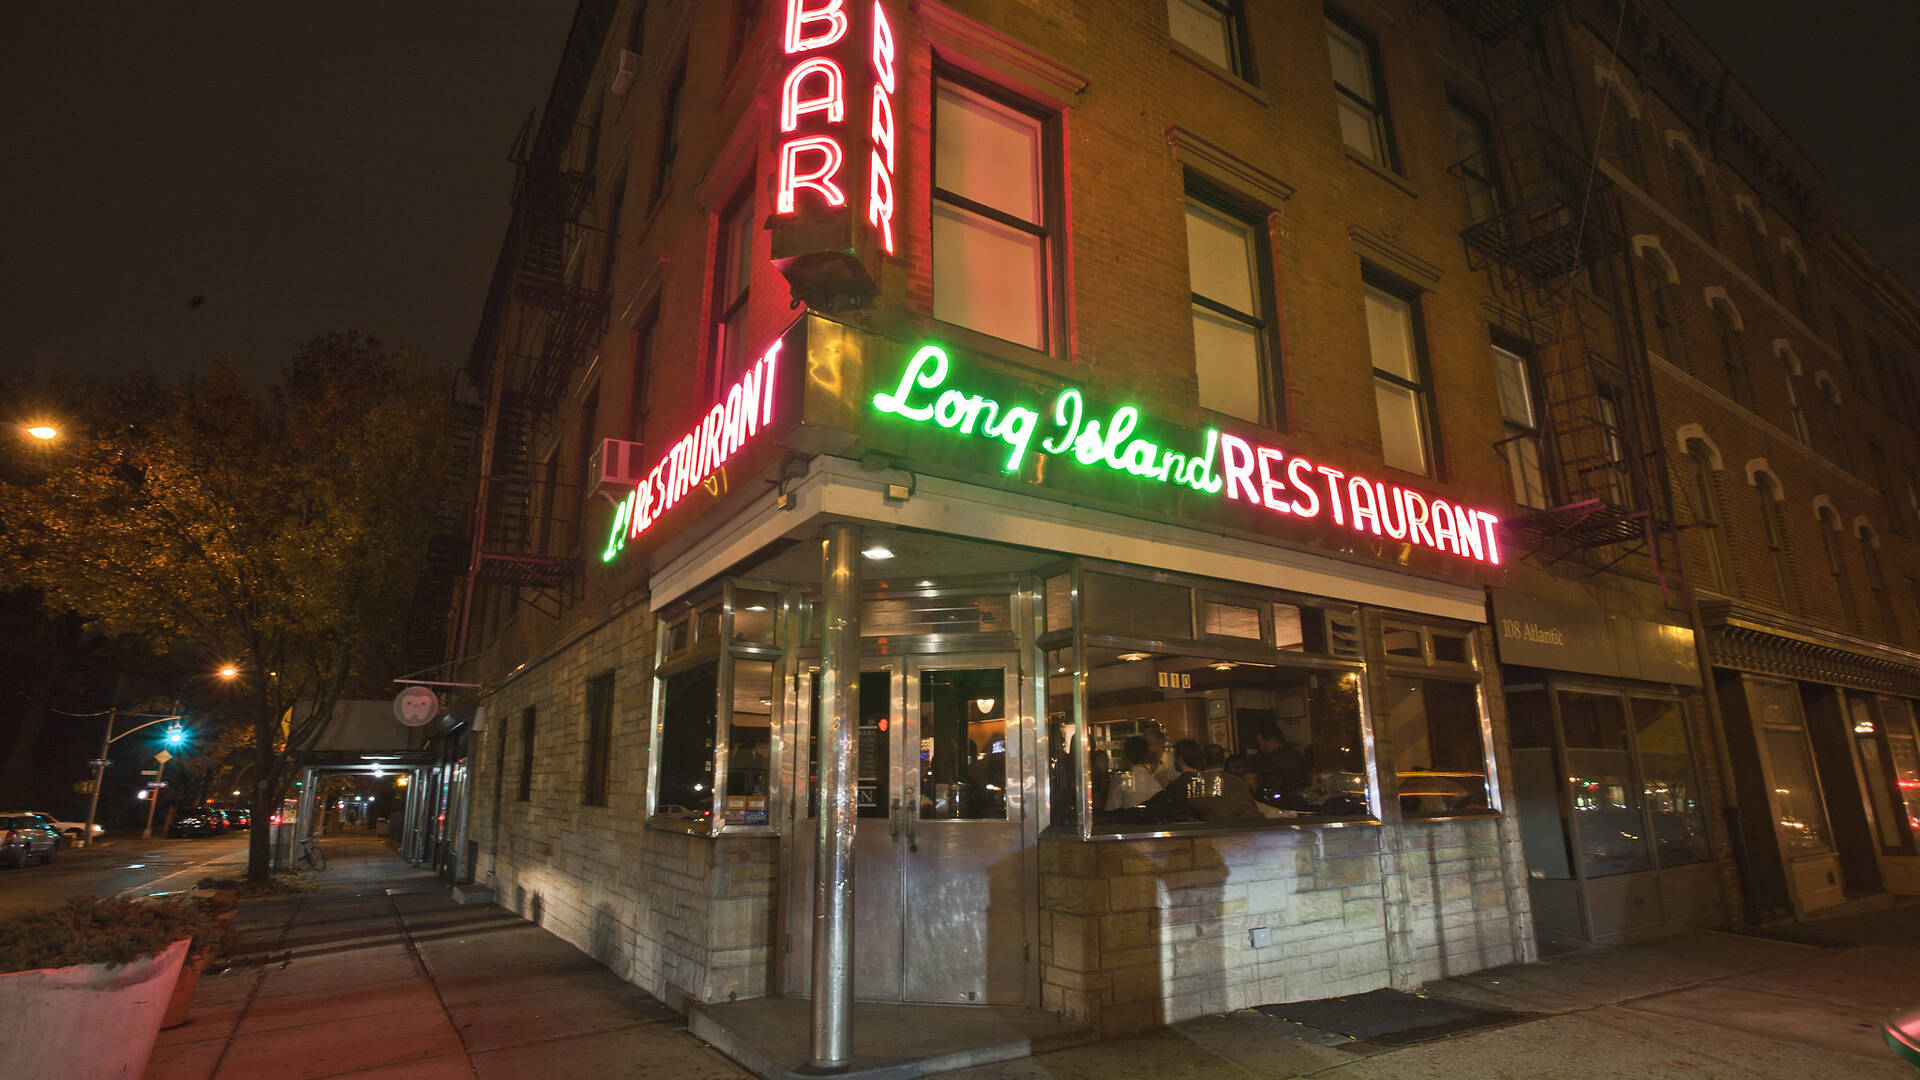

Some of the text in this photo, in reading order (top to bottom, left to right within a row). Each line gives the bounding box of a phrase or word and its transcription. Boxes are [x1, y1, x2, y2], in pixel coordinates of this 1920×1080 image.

[777, 0, 848, 214] BAR
[869, 0, 895, 256] BAR
[631, 337, 784, 539] RESTAURANT
[872, 344, 1500, 565] Long Island RESTAURANT
[1160, 672, 1190, 688] 110
[1502, 619, 1565, 646] 108 Atlantic
